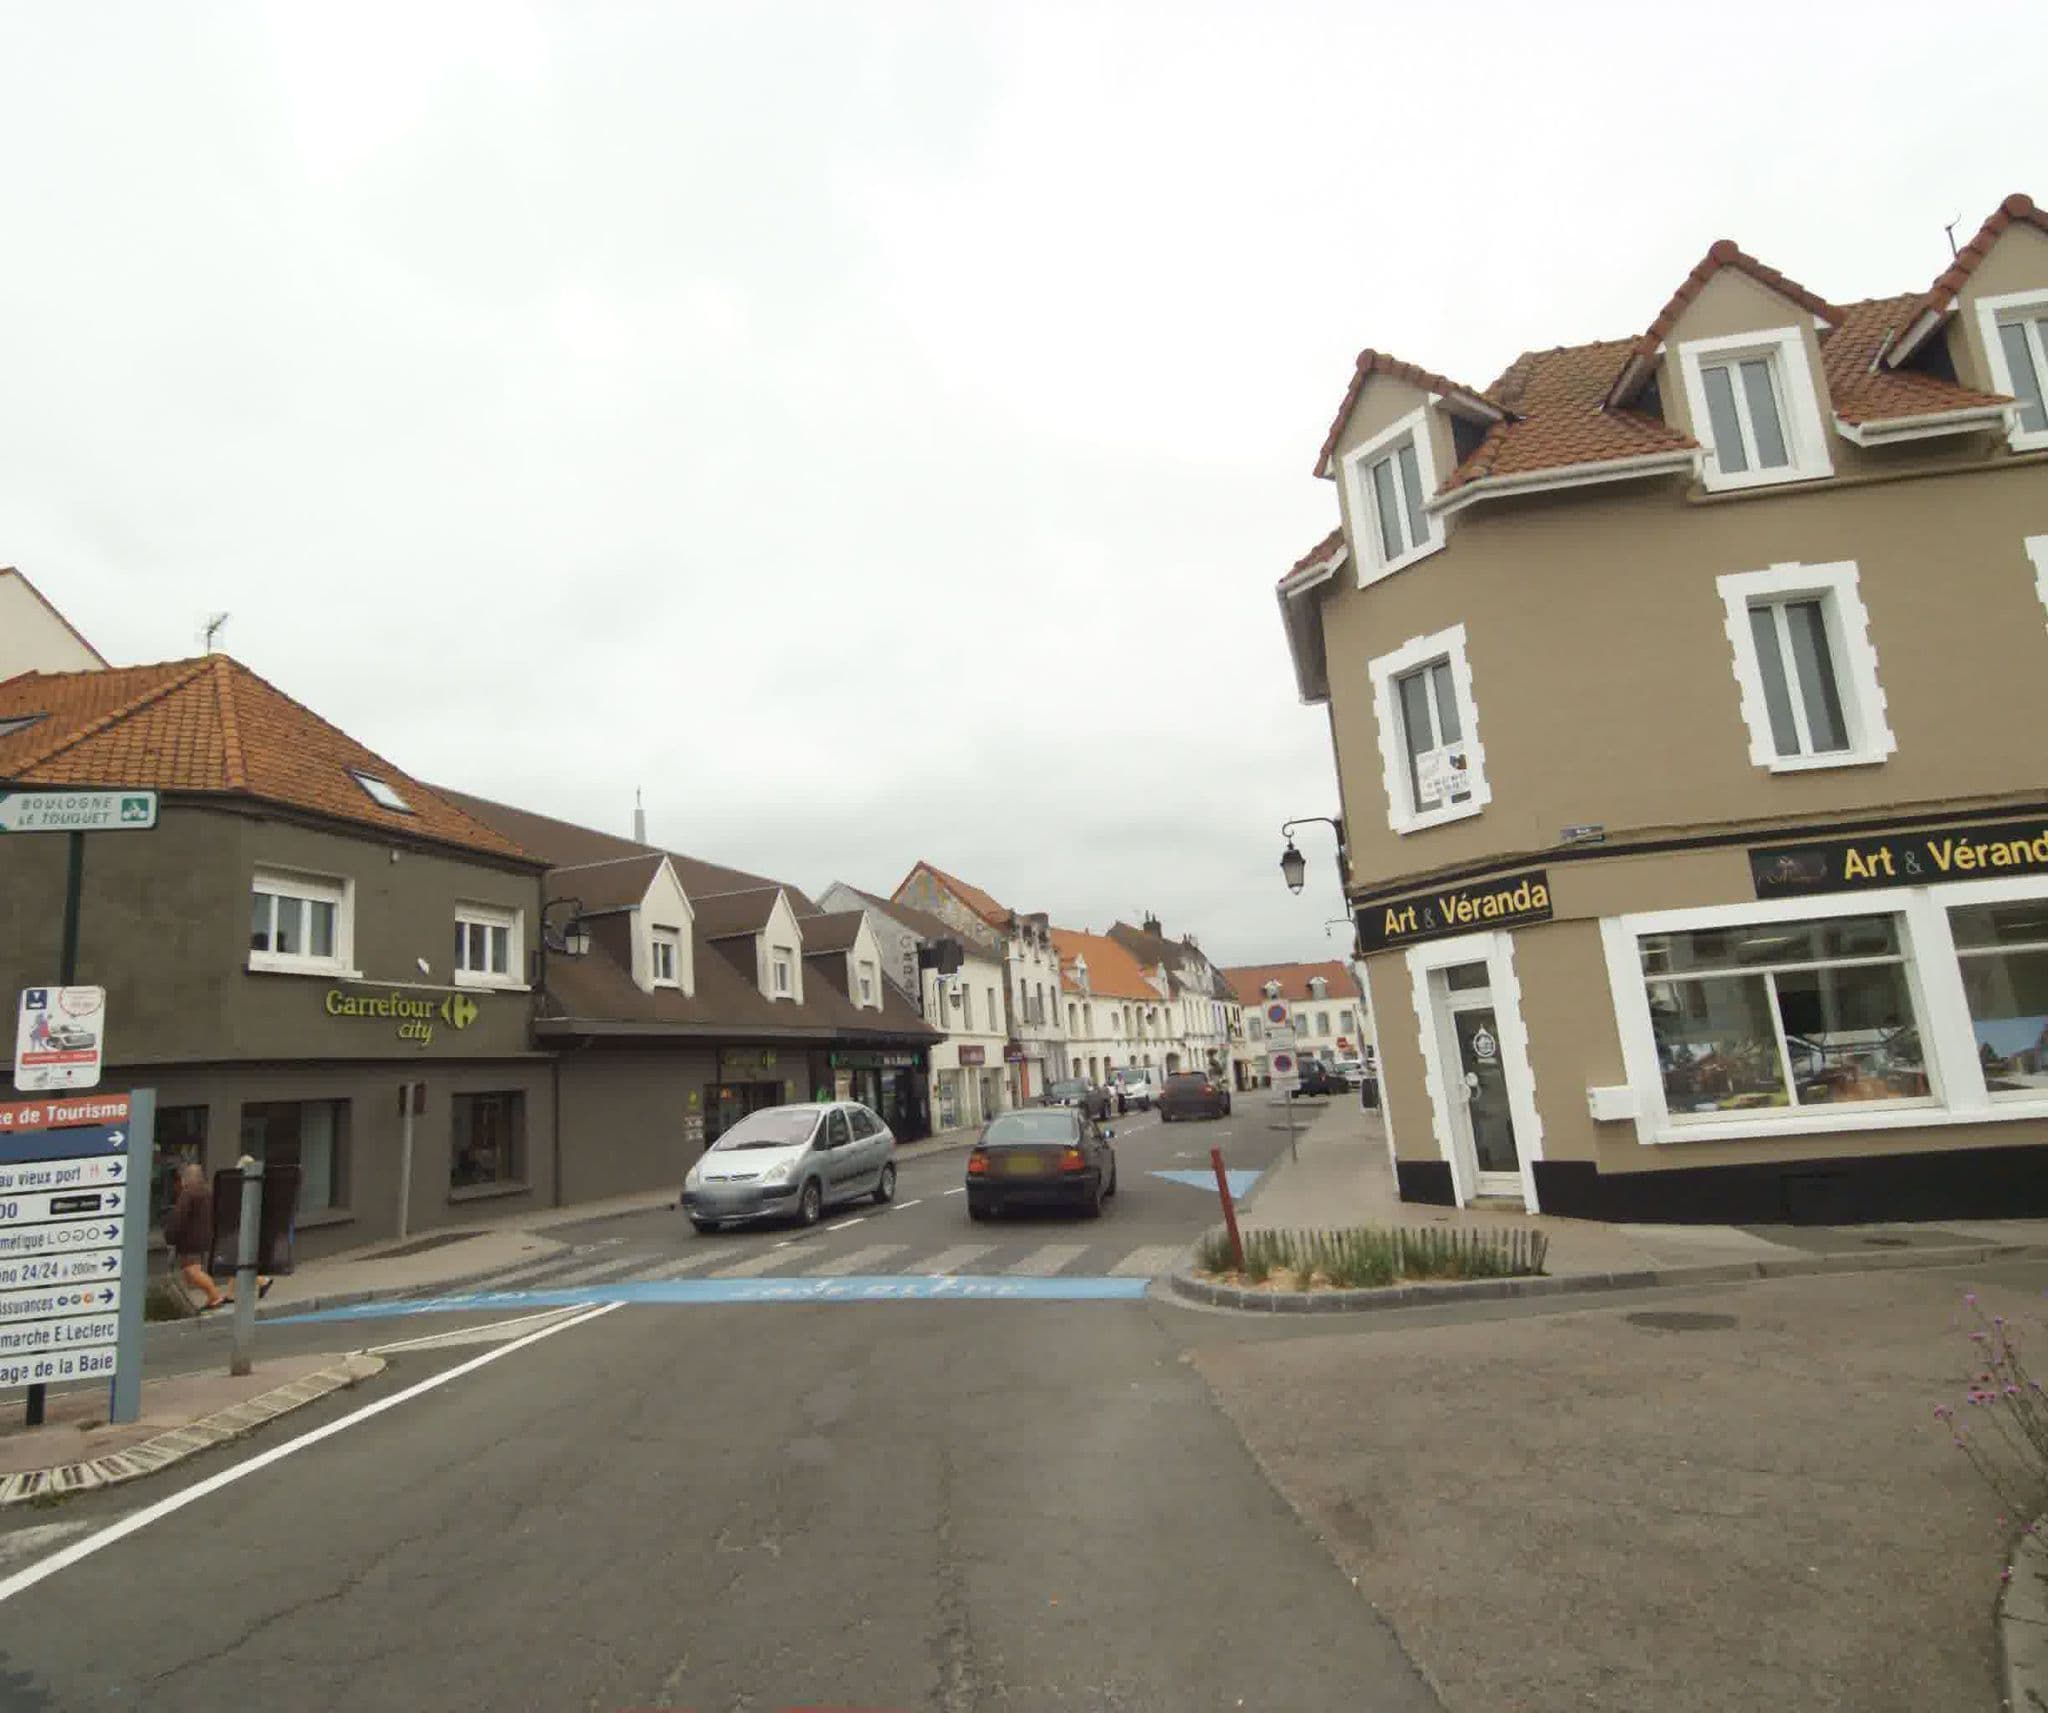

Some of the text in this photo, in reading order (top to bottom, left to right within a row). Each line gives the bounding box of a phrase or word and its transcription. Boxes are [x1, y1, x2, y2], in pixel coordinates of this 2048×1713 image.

[21, 797, 113, 810] BOULOGNE
[18, 812, 112, 825] LE TOUQUET
[1844, 846, 1896, 880] Art
[1905, 851, 1924, 875] &
[1384, 879, 1550, 936] Art & Véranda
[326, 989, 434, 1018] Carrefour
[398, 1020, 433, 1046] city
[0, 1103, 128, 1125] e de Tourisme
[18, 1170, 51, 1185] vieux
[56, 1167, 81, 1184] port
[67, 1323, 114, 1341] Leclerc
[35, 1361, 53, 1377] de
[59, 1358, 73, 1374] la
[80, 1355, 113, 1373] Baie
